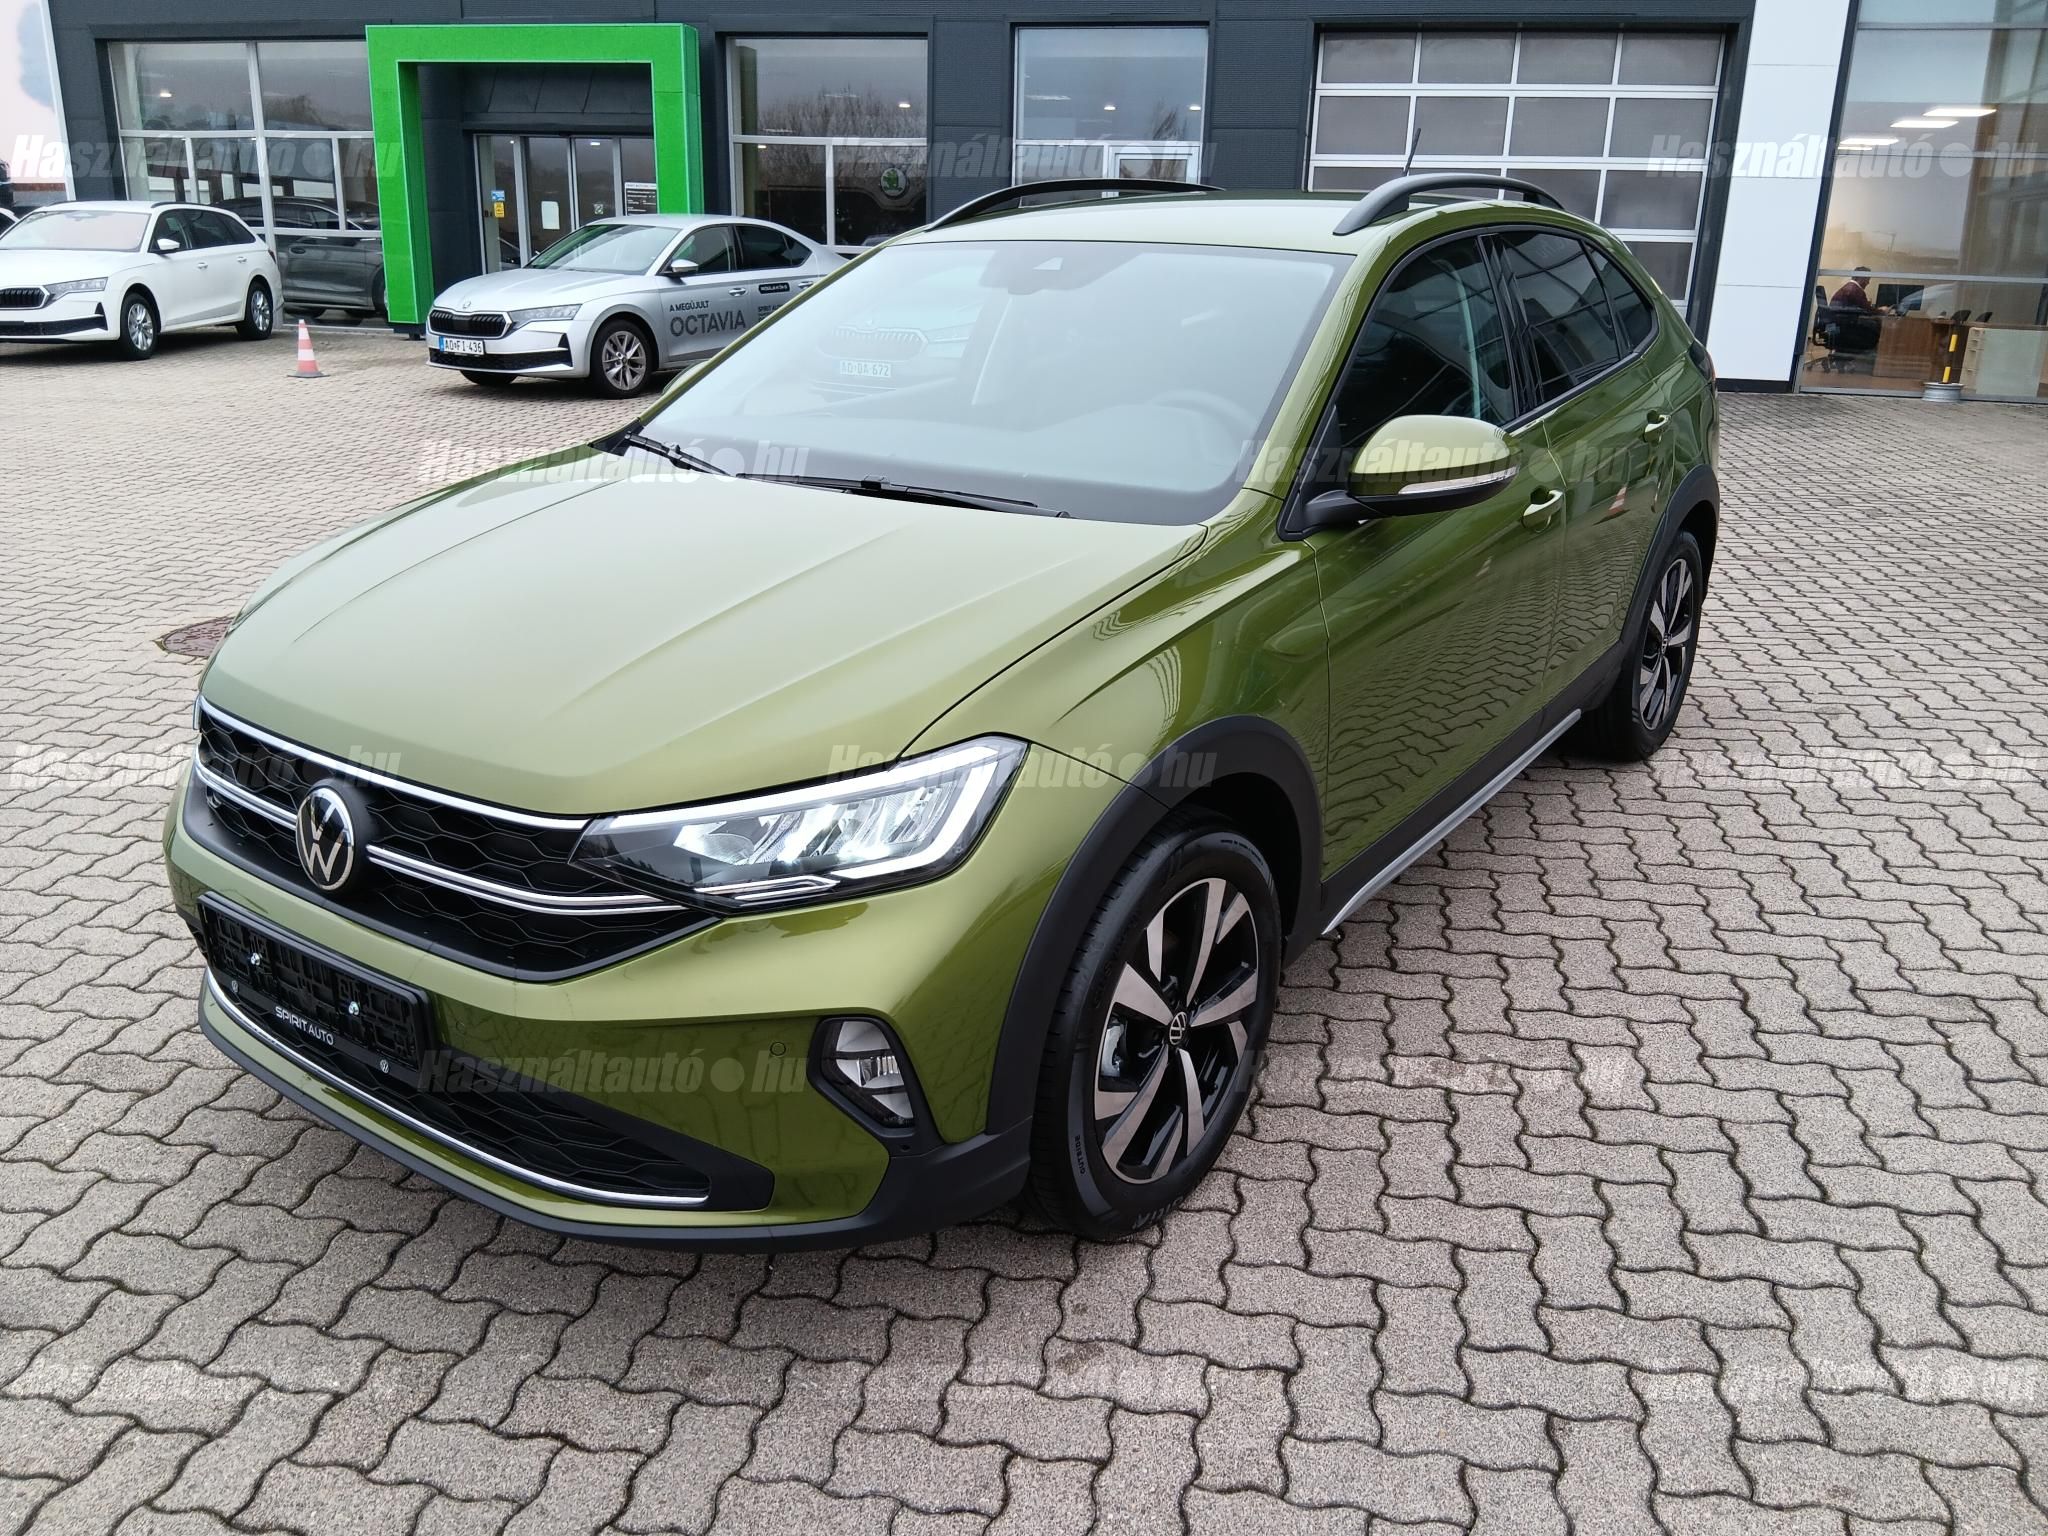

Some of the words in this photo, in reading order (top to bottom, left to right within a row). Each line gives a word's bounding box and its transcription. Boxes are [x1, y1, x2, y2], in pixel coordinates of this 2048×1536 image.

[670, 310, 746, 337] OCTAVIA
[275, 1006, 308, 1032] SPIRIT
[308, 1024, 334, 1046] AUTO
